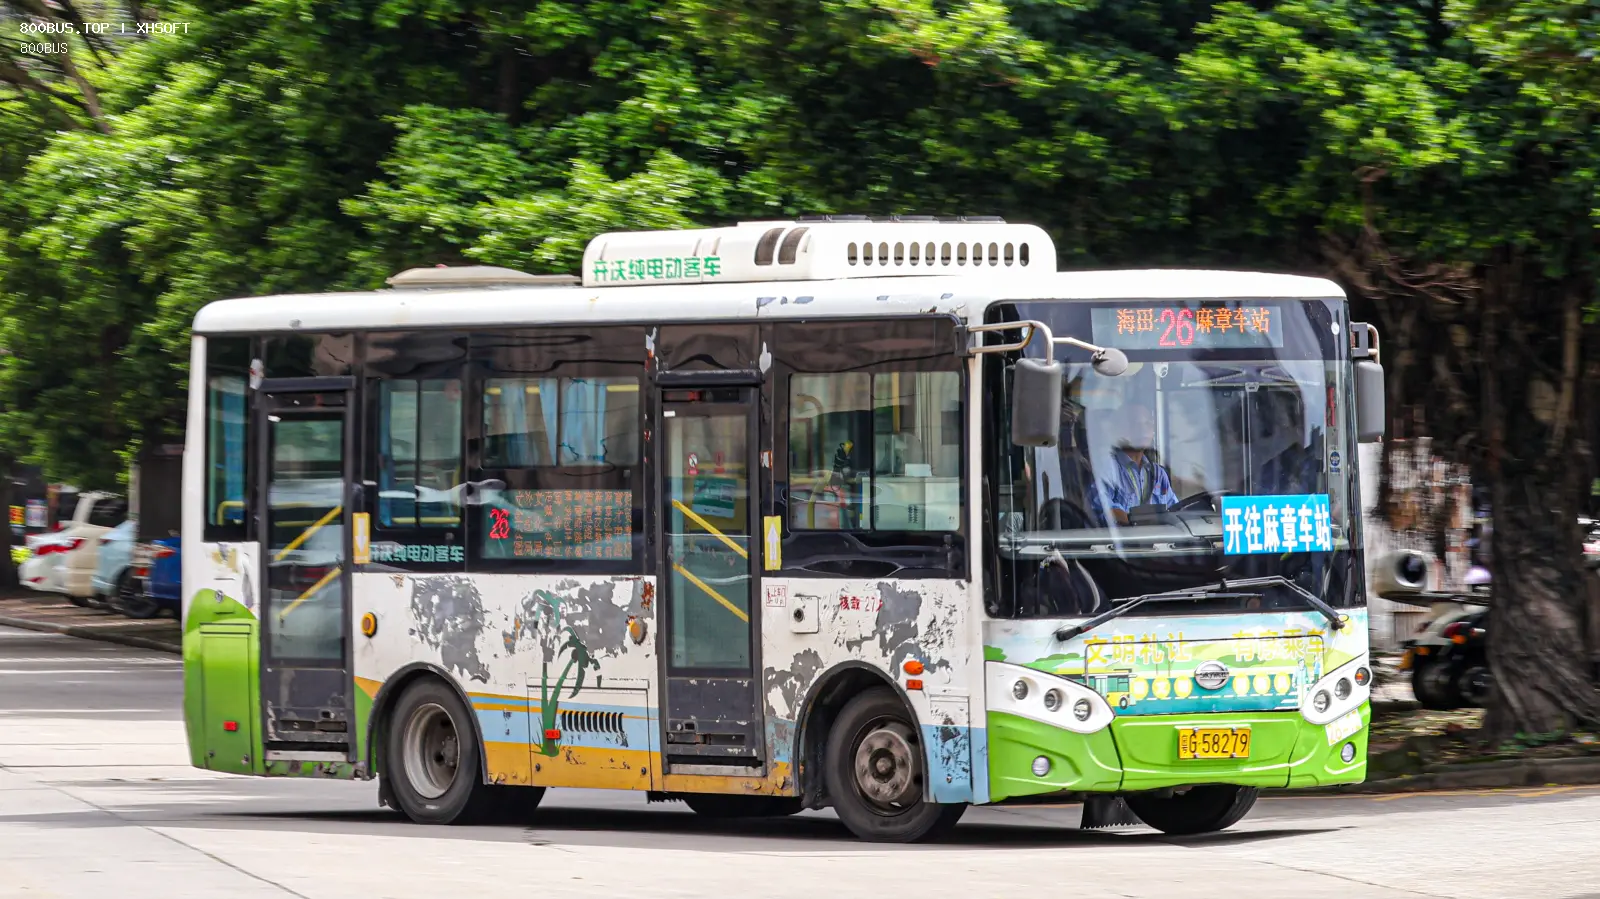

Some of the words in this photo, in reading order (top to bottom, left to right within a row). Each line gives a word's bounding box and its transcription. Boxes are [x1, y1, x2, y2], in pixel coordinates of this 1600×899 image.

[593, 256, 721, 281] 开沃纯电动客车
[1117, 308, 1153, 335] 海田
[1159, 307, 1194, 346] 26
[1195, 307, 1270, 334] 麻章车站
[489, 508, 511, 539] 26
[1224, 503, 1332, 553] 开往麻章车站
[1083, 631, 1192, 665] 文明礼让
